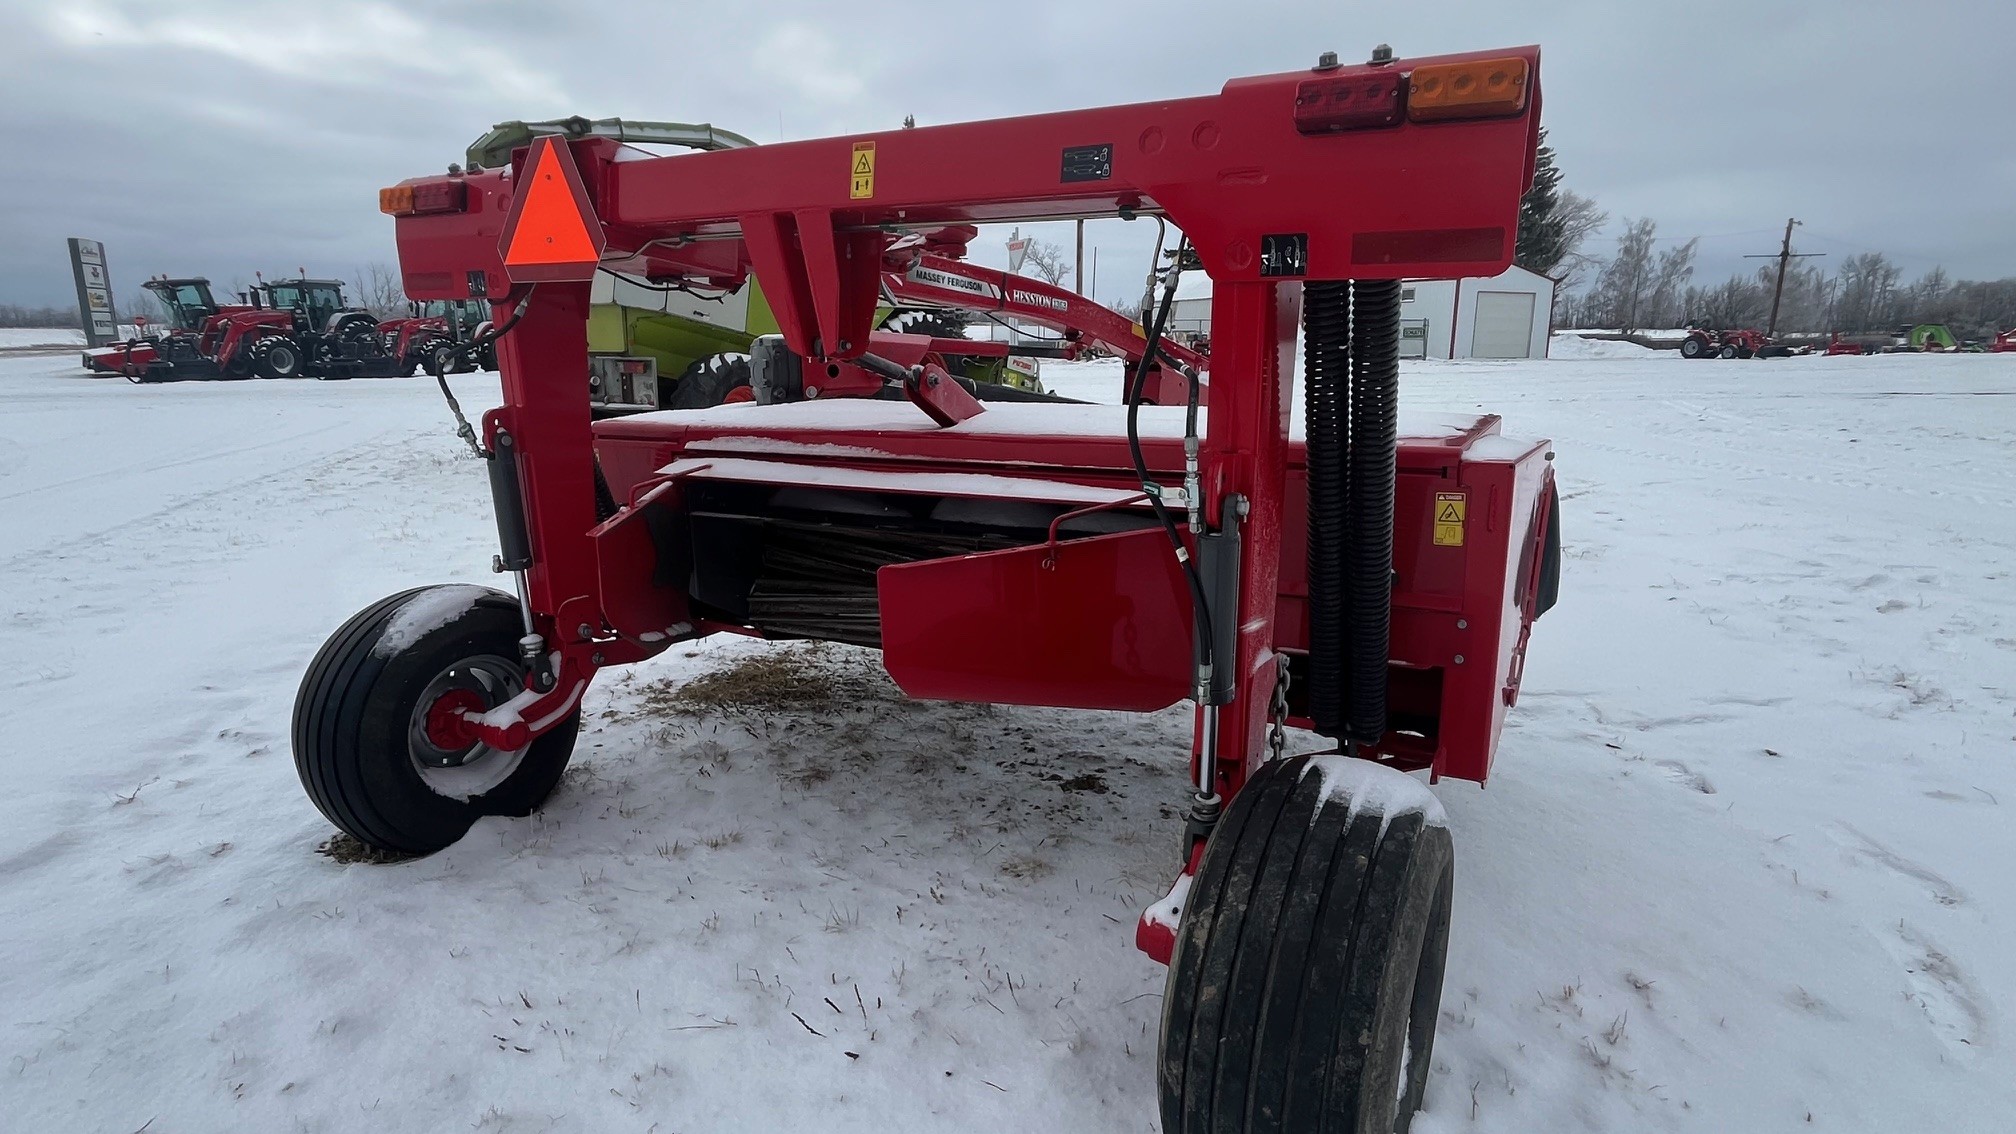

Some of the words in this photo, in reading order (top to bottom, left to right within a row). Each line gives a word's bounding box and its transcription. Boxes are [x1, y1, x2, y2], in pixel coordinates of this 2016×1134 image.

[915, 269, 946, 284] MASSEY
[947, 276, 983, 291] FERGUSON
[1013, 289, 1052, 308] HESSTON
